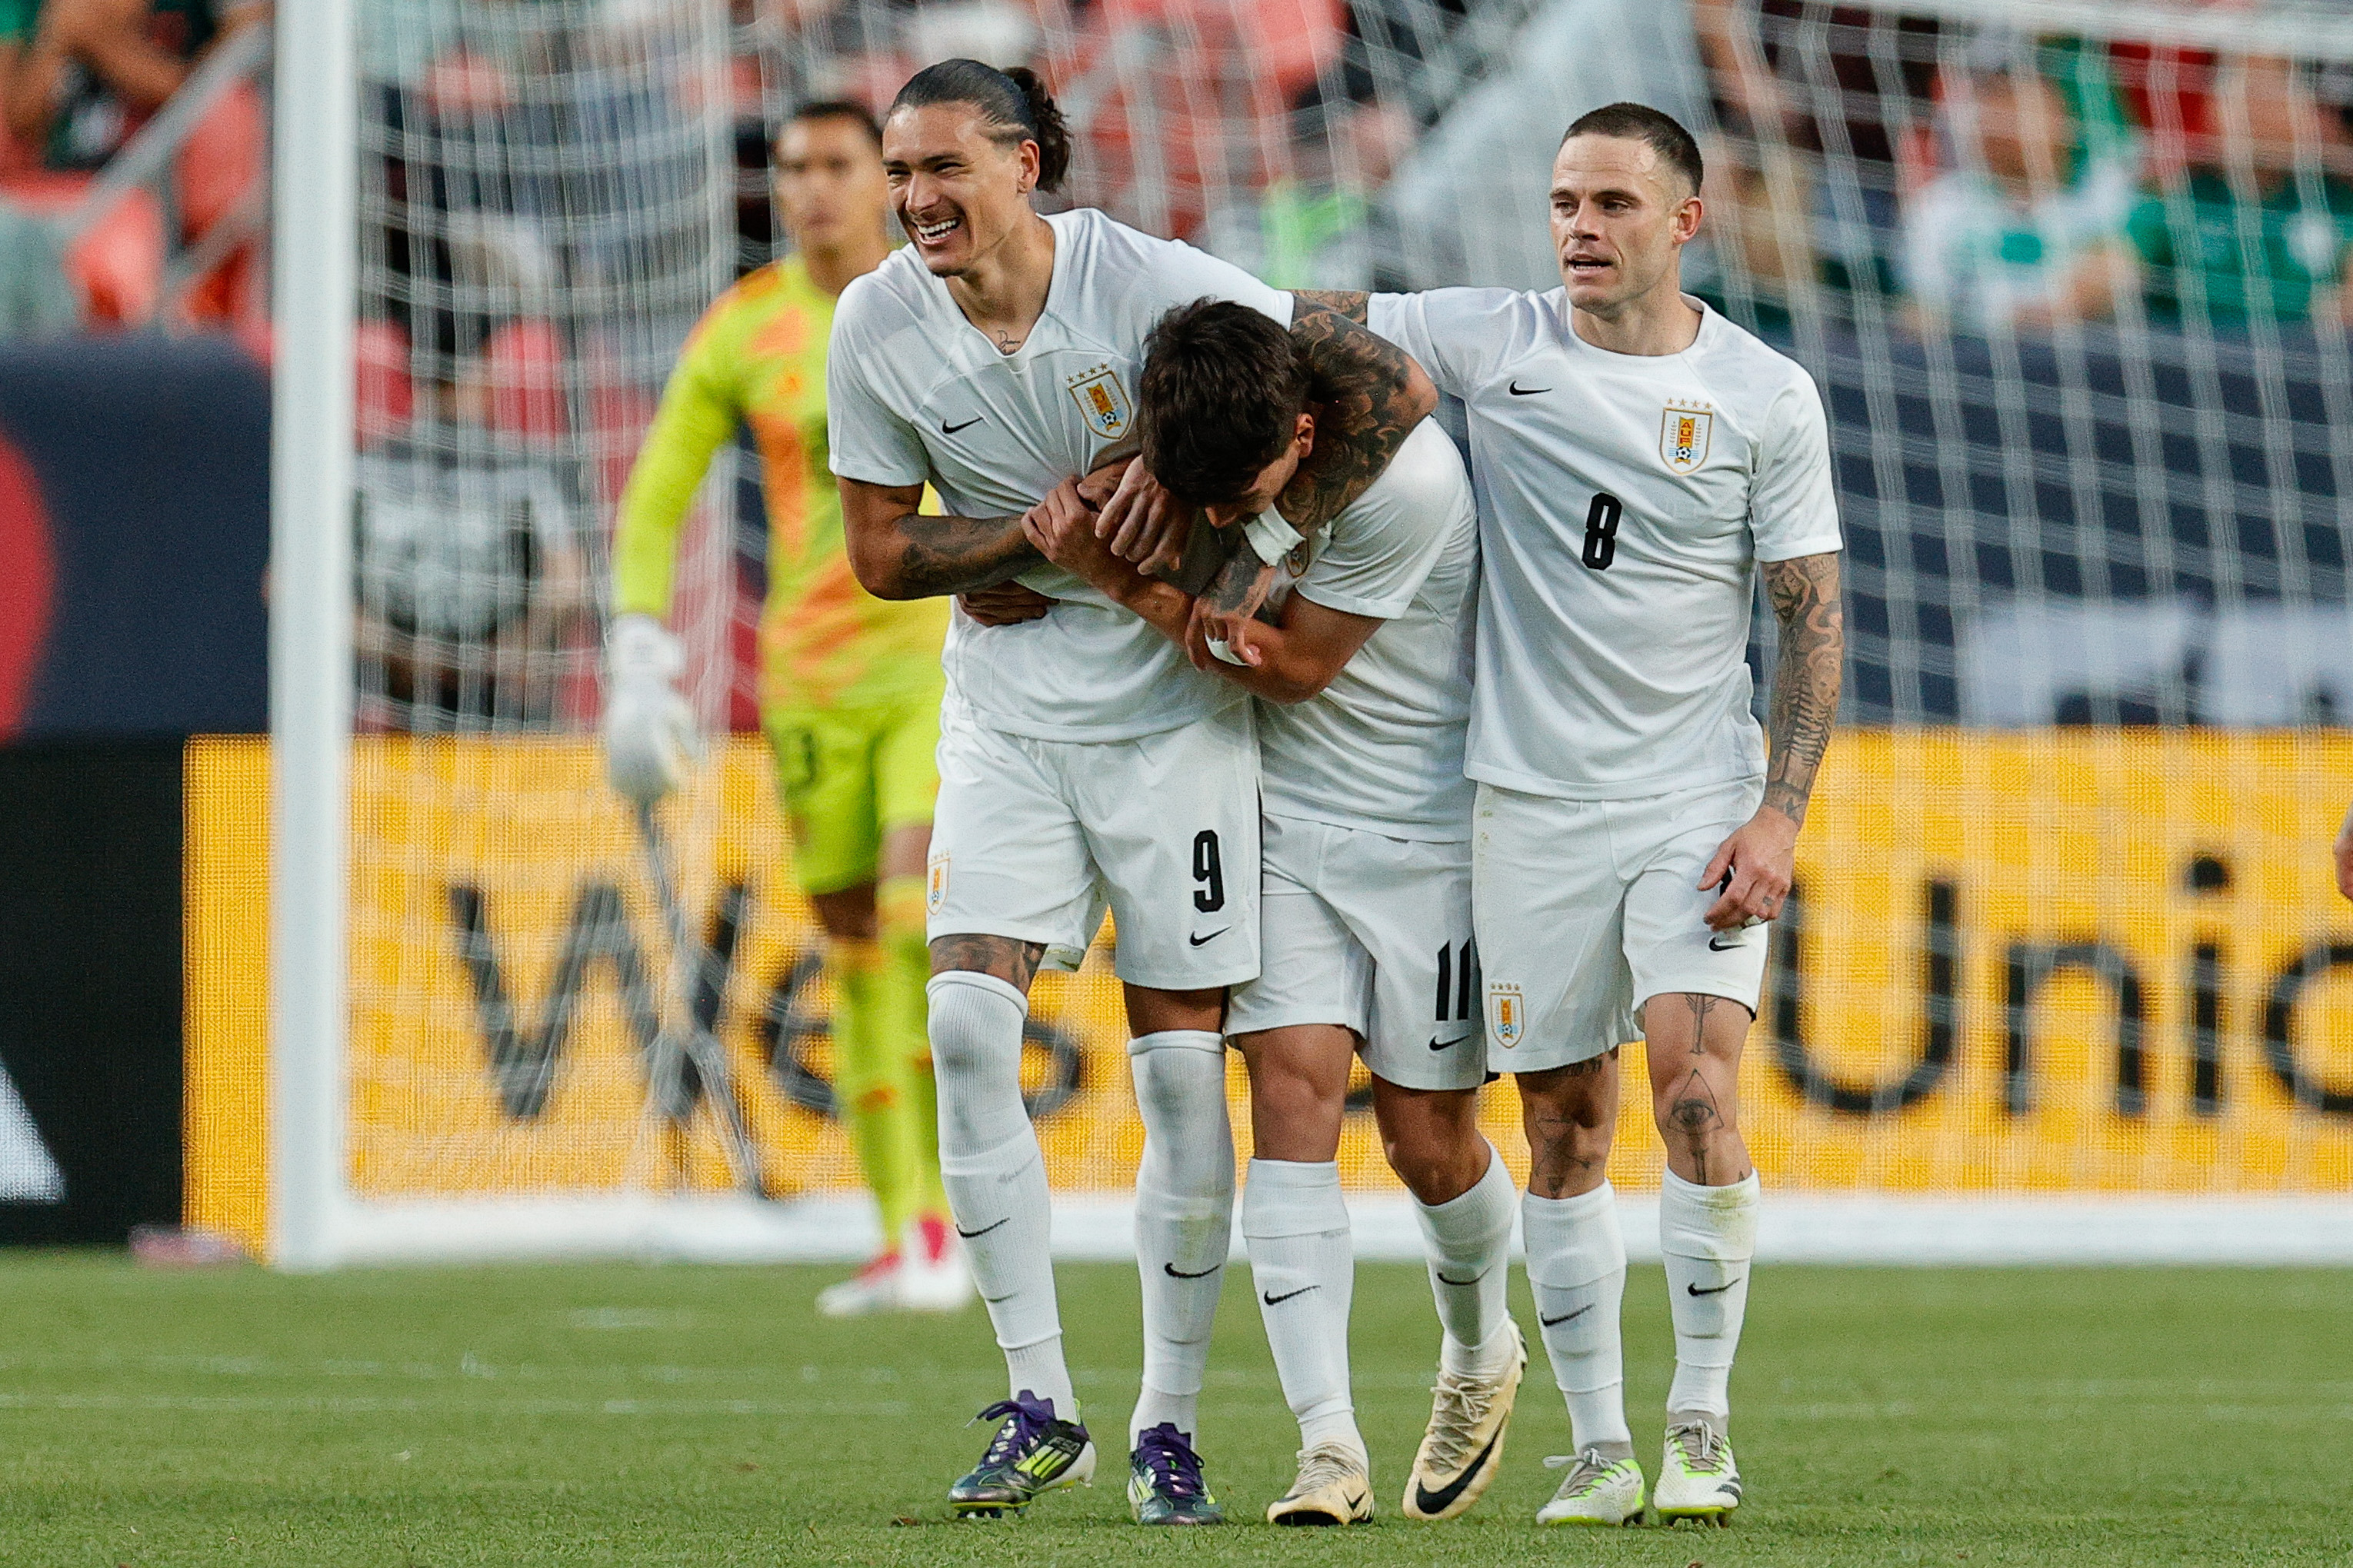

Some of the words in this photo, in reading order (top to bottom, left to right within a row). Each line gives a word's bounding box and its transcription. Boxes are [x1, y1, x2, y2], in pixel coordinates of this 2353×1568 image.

[1678, 421, 1692, 444] AUF
[1581, 492, 1623, 571] 8
[1192, 829, 1225, 913] 9
[1435, 937, 1471, 1021] 11
